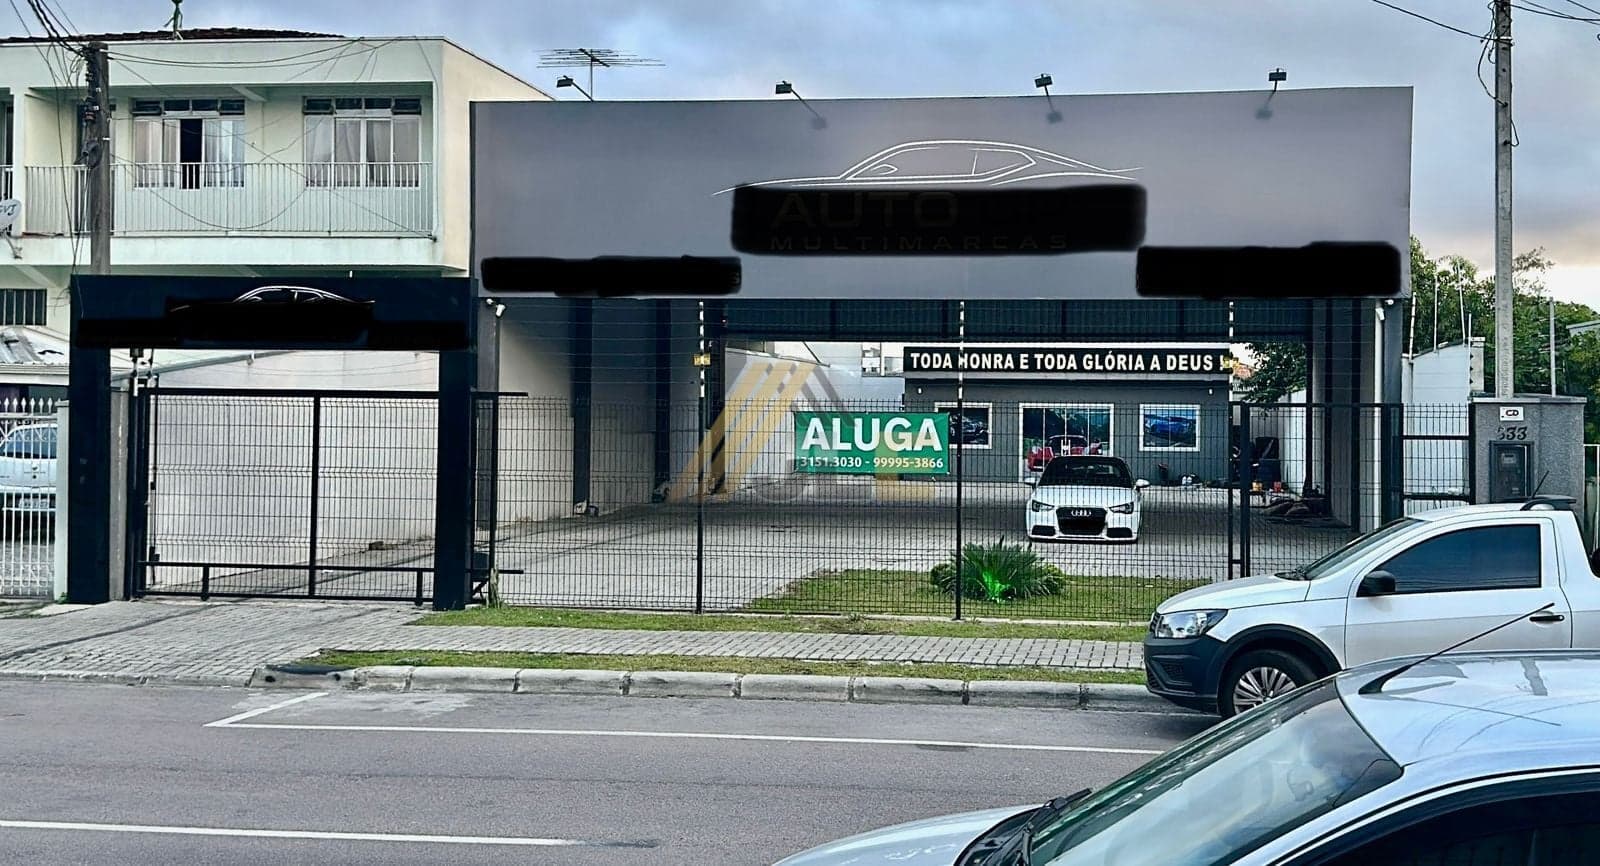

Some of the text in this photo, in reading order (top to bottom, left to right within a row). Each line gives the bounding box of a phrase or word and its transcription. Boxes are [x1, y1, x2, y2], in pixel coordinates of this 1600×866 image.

[773, 192, 959, 228] AUTO
[910, 352, 953, 369] TODA
[958, 353, 1015, 370] HONRA
[1019, 353, 1030, 370] E
[1034, 353, 1078, 370] TODA
[1082, 350, 1145, 371] GLÓRIA
[1150, 354, 1161, 371] A
[1166, 354, 1213, 371] DEUS
[800, 417, 943, 452] ALUGA
[801, 456, 862, 468] 3151.3030
[873, 457, 944, 469] 99995-3866
